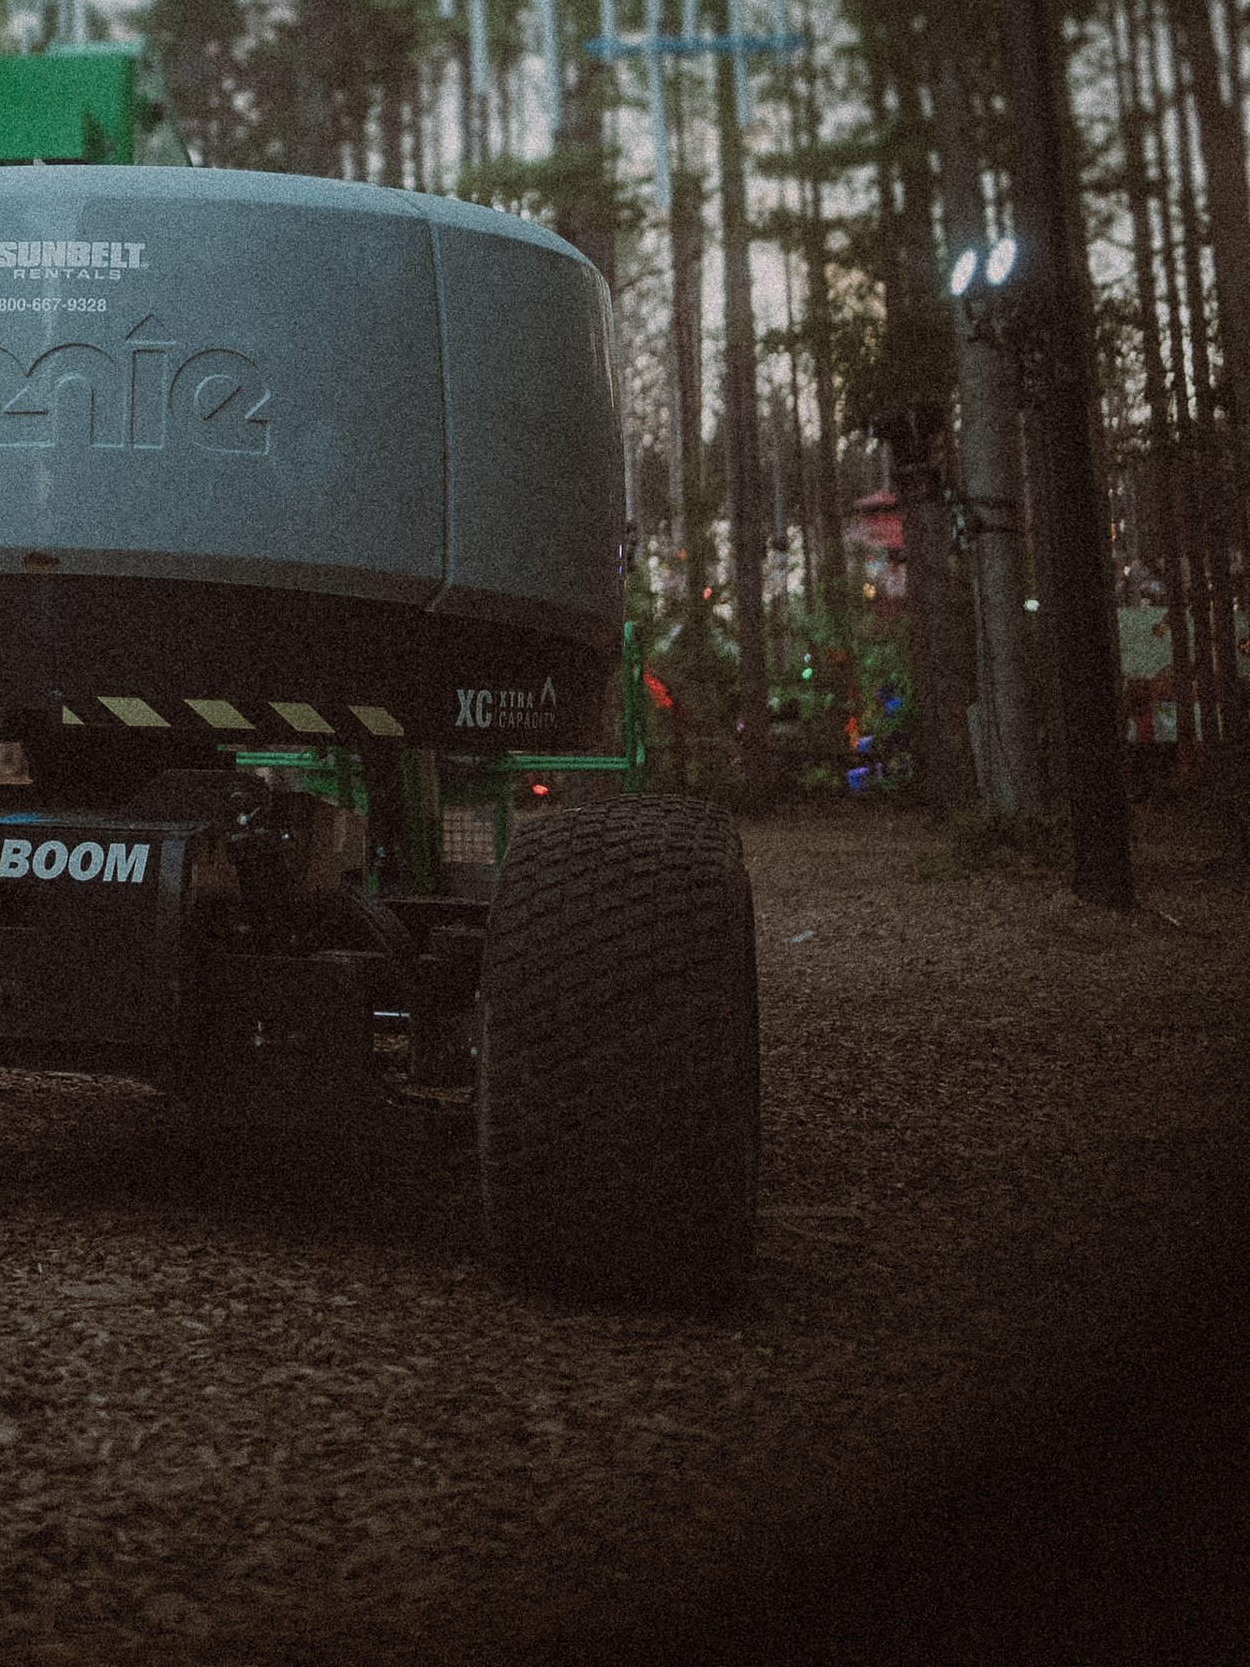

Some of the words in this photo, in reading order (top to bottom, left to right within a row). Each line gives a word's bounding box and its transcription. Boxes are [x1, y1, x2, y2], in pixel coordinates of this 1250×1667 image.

[13, 268, 122, 280] RENTALS
[455, 689, 493, 728] XC
[500, 690, 534, 709] XTRA
[499, 711, 556, 729] CAPACITY
